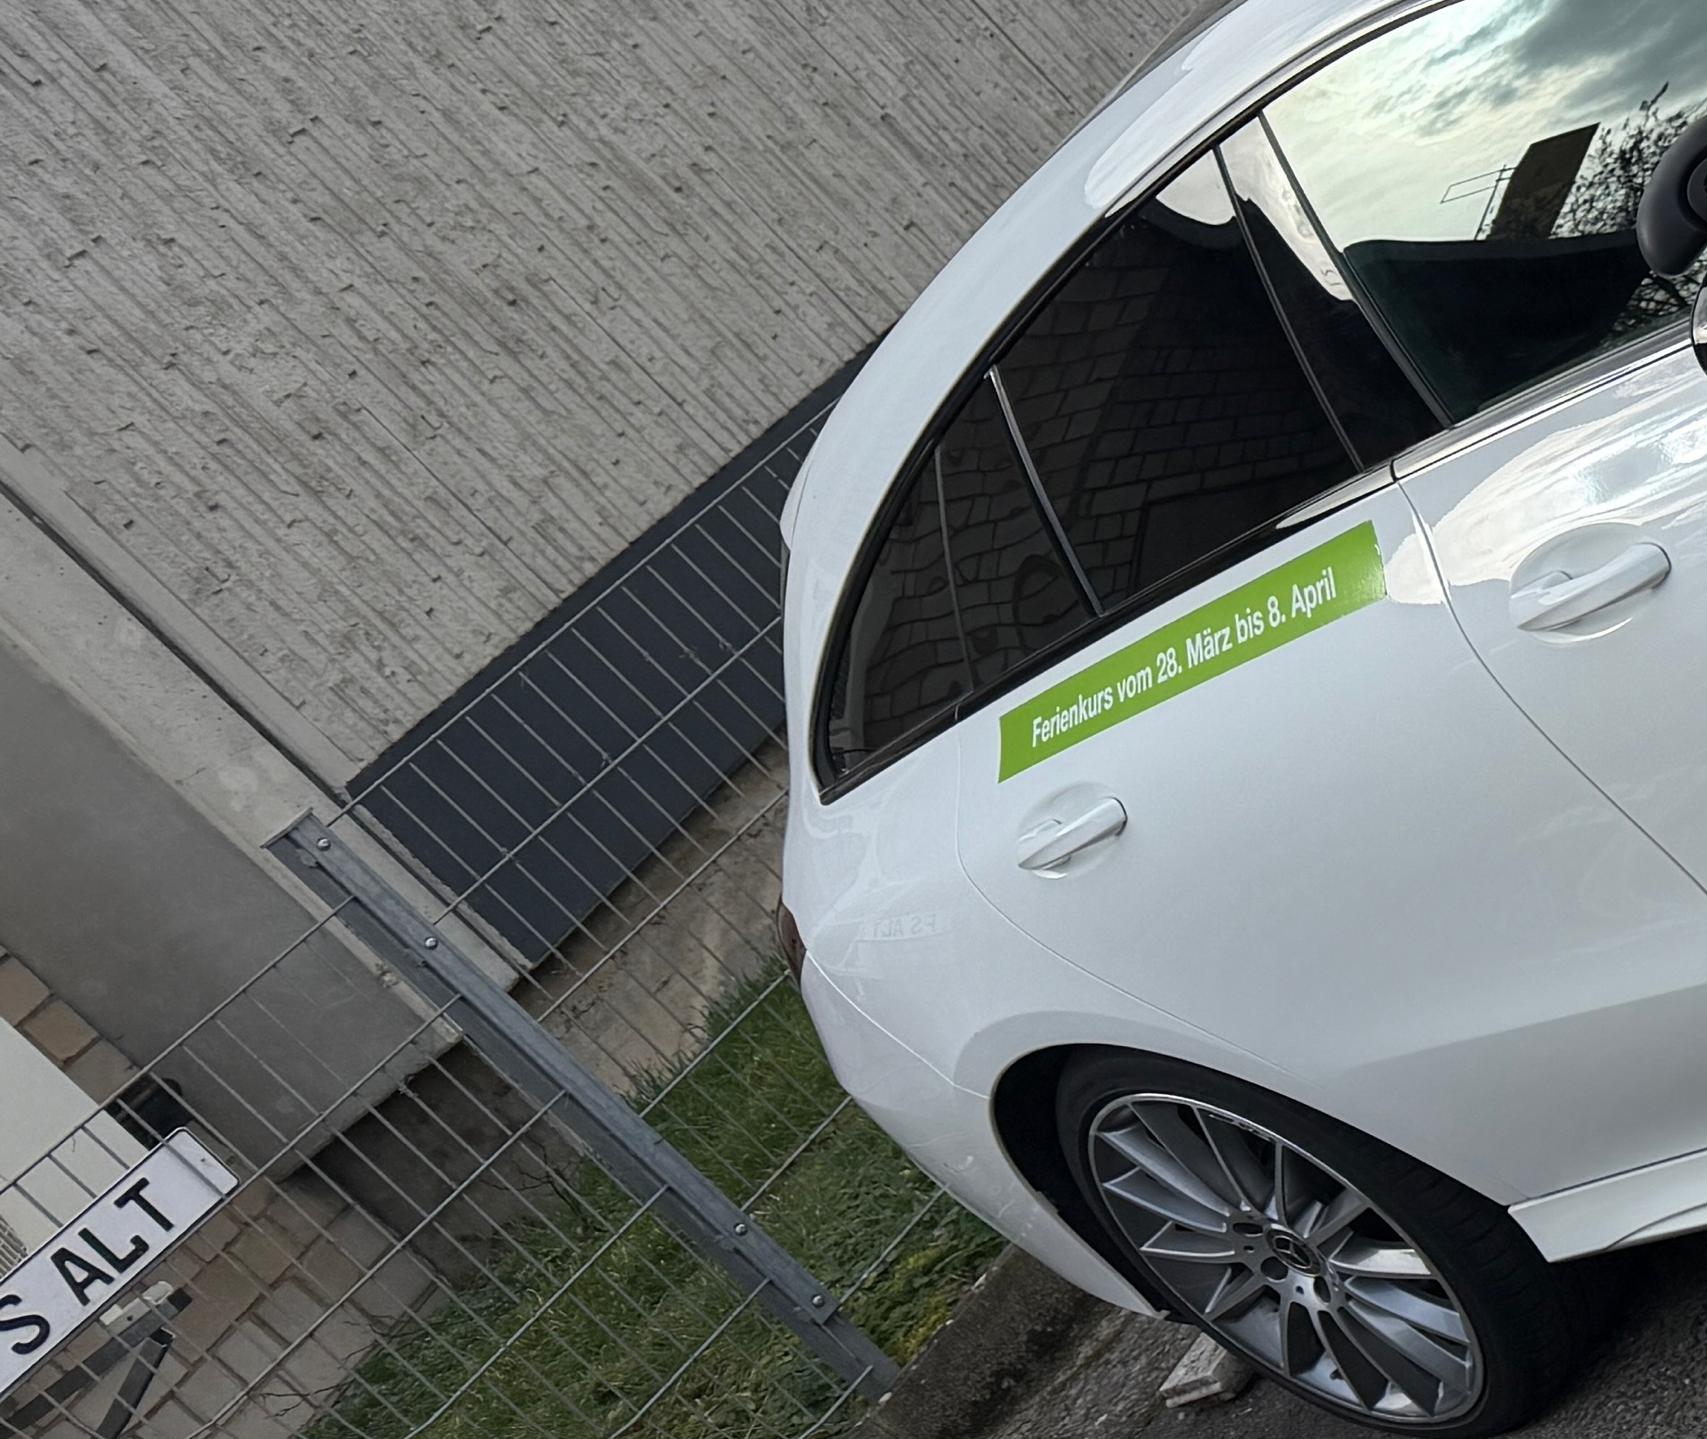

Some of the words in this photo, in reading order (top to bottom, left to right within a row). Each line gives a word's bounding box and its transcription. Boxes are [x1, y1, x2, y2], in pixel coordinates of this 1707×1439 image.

[1032, 685, 1113, 747] Ferienkurs
[1116, 664, 1153, 702] vom
[1156, 647, 1182, 684] 28.
[1186, 626, 1233, 668] März
[1236, 607, 1264, 645] bis
[1267, 595, 1286, 628] 8.
[1291, 566, 1336, 619] April
[50, 1177, 174, 1306] ALT
